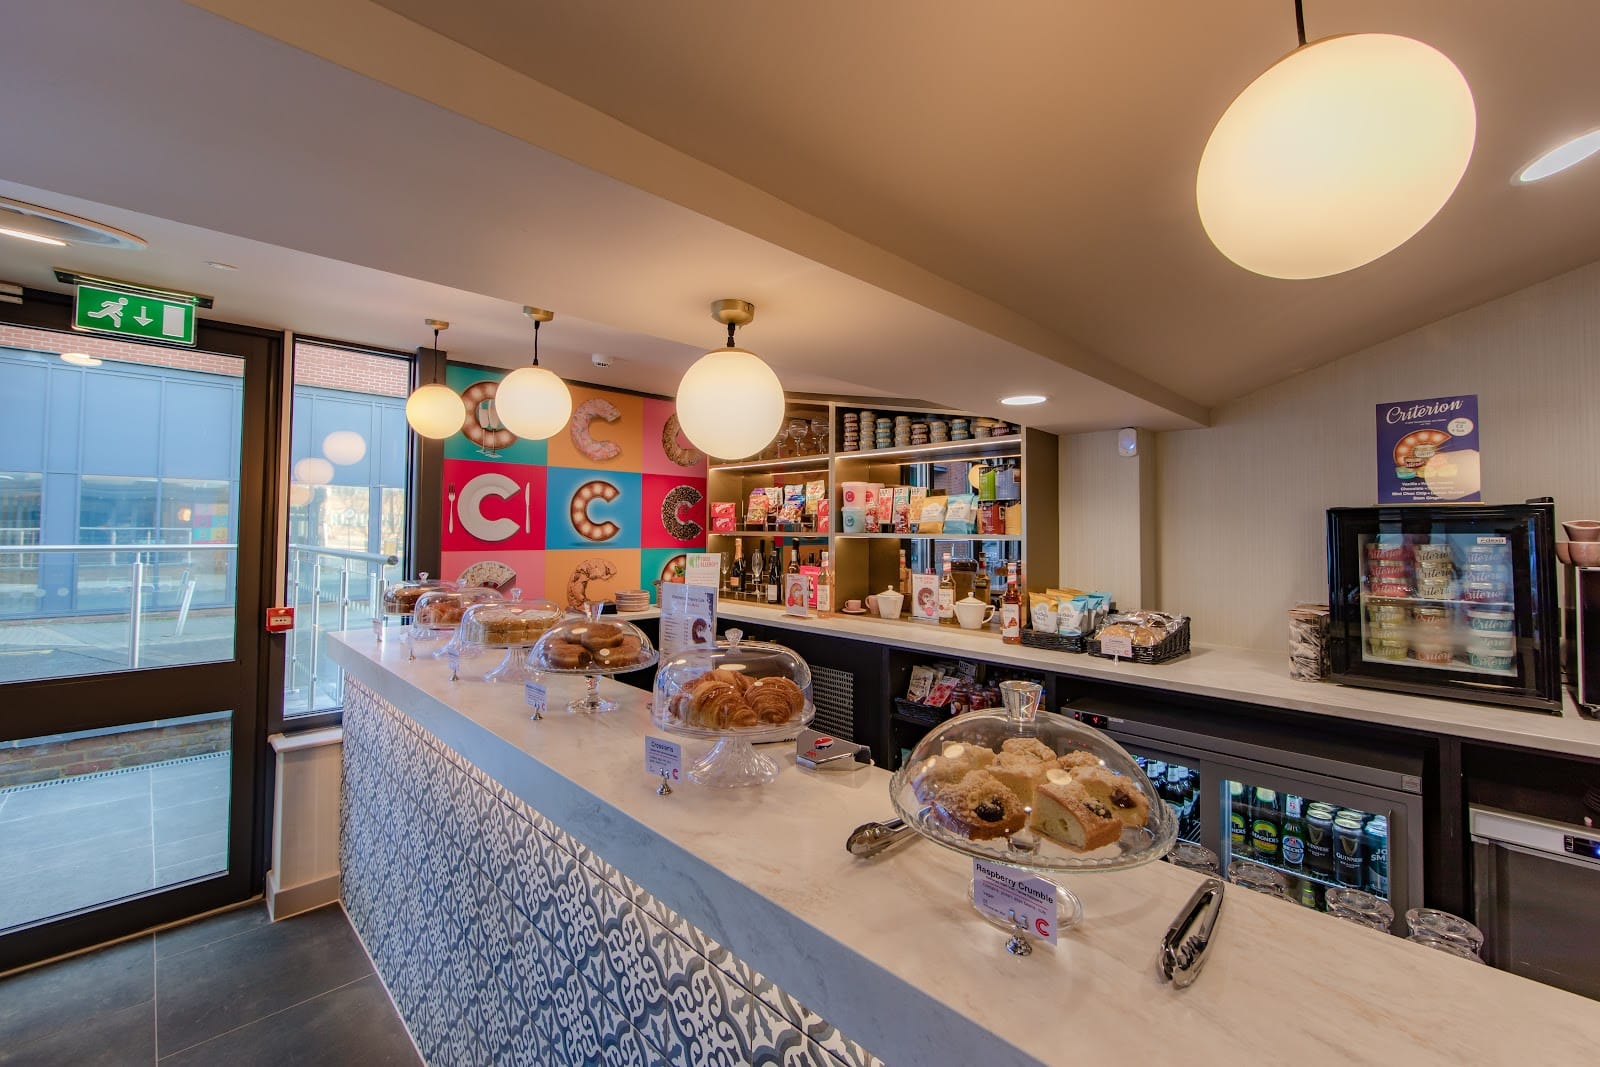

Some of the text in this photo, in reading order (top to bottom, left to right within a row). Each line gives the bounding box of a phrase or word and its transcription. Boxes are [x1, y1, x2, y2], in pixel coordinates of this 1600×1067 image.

[1386, 399, 1463, 424] Criterion
[976, 863, 1017, 889] Raspberry
[1017, 881, 1054, 904] Crumble
